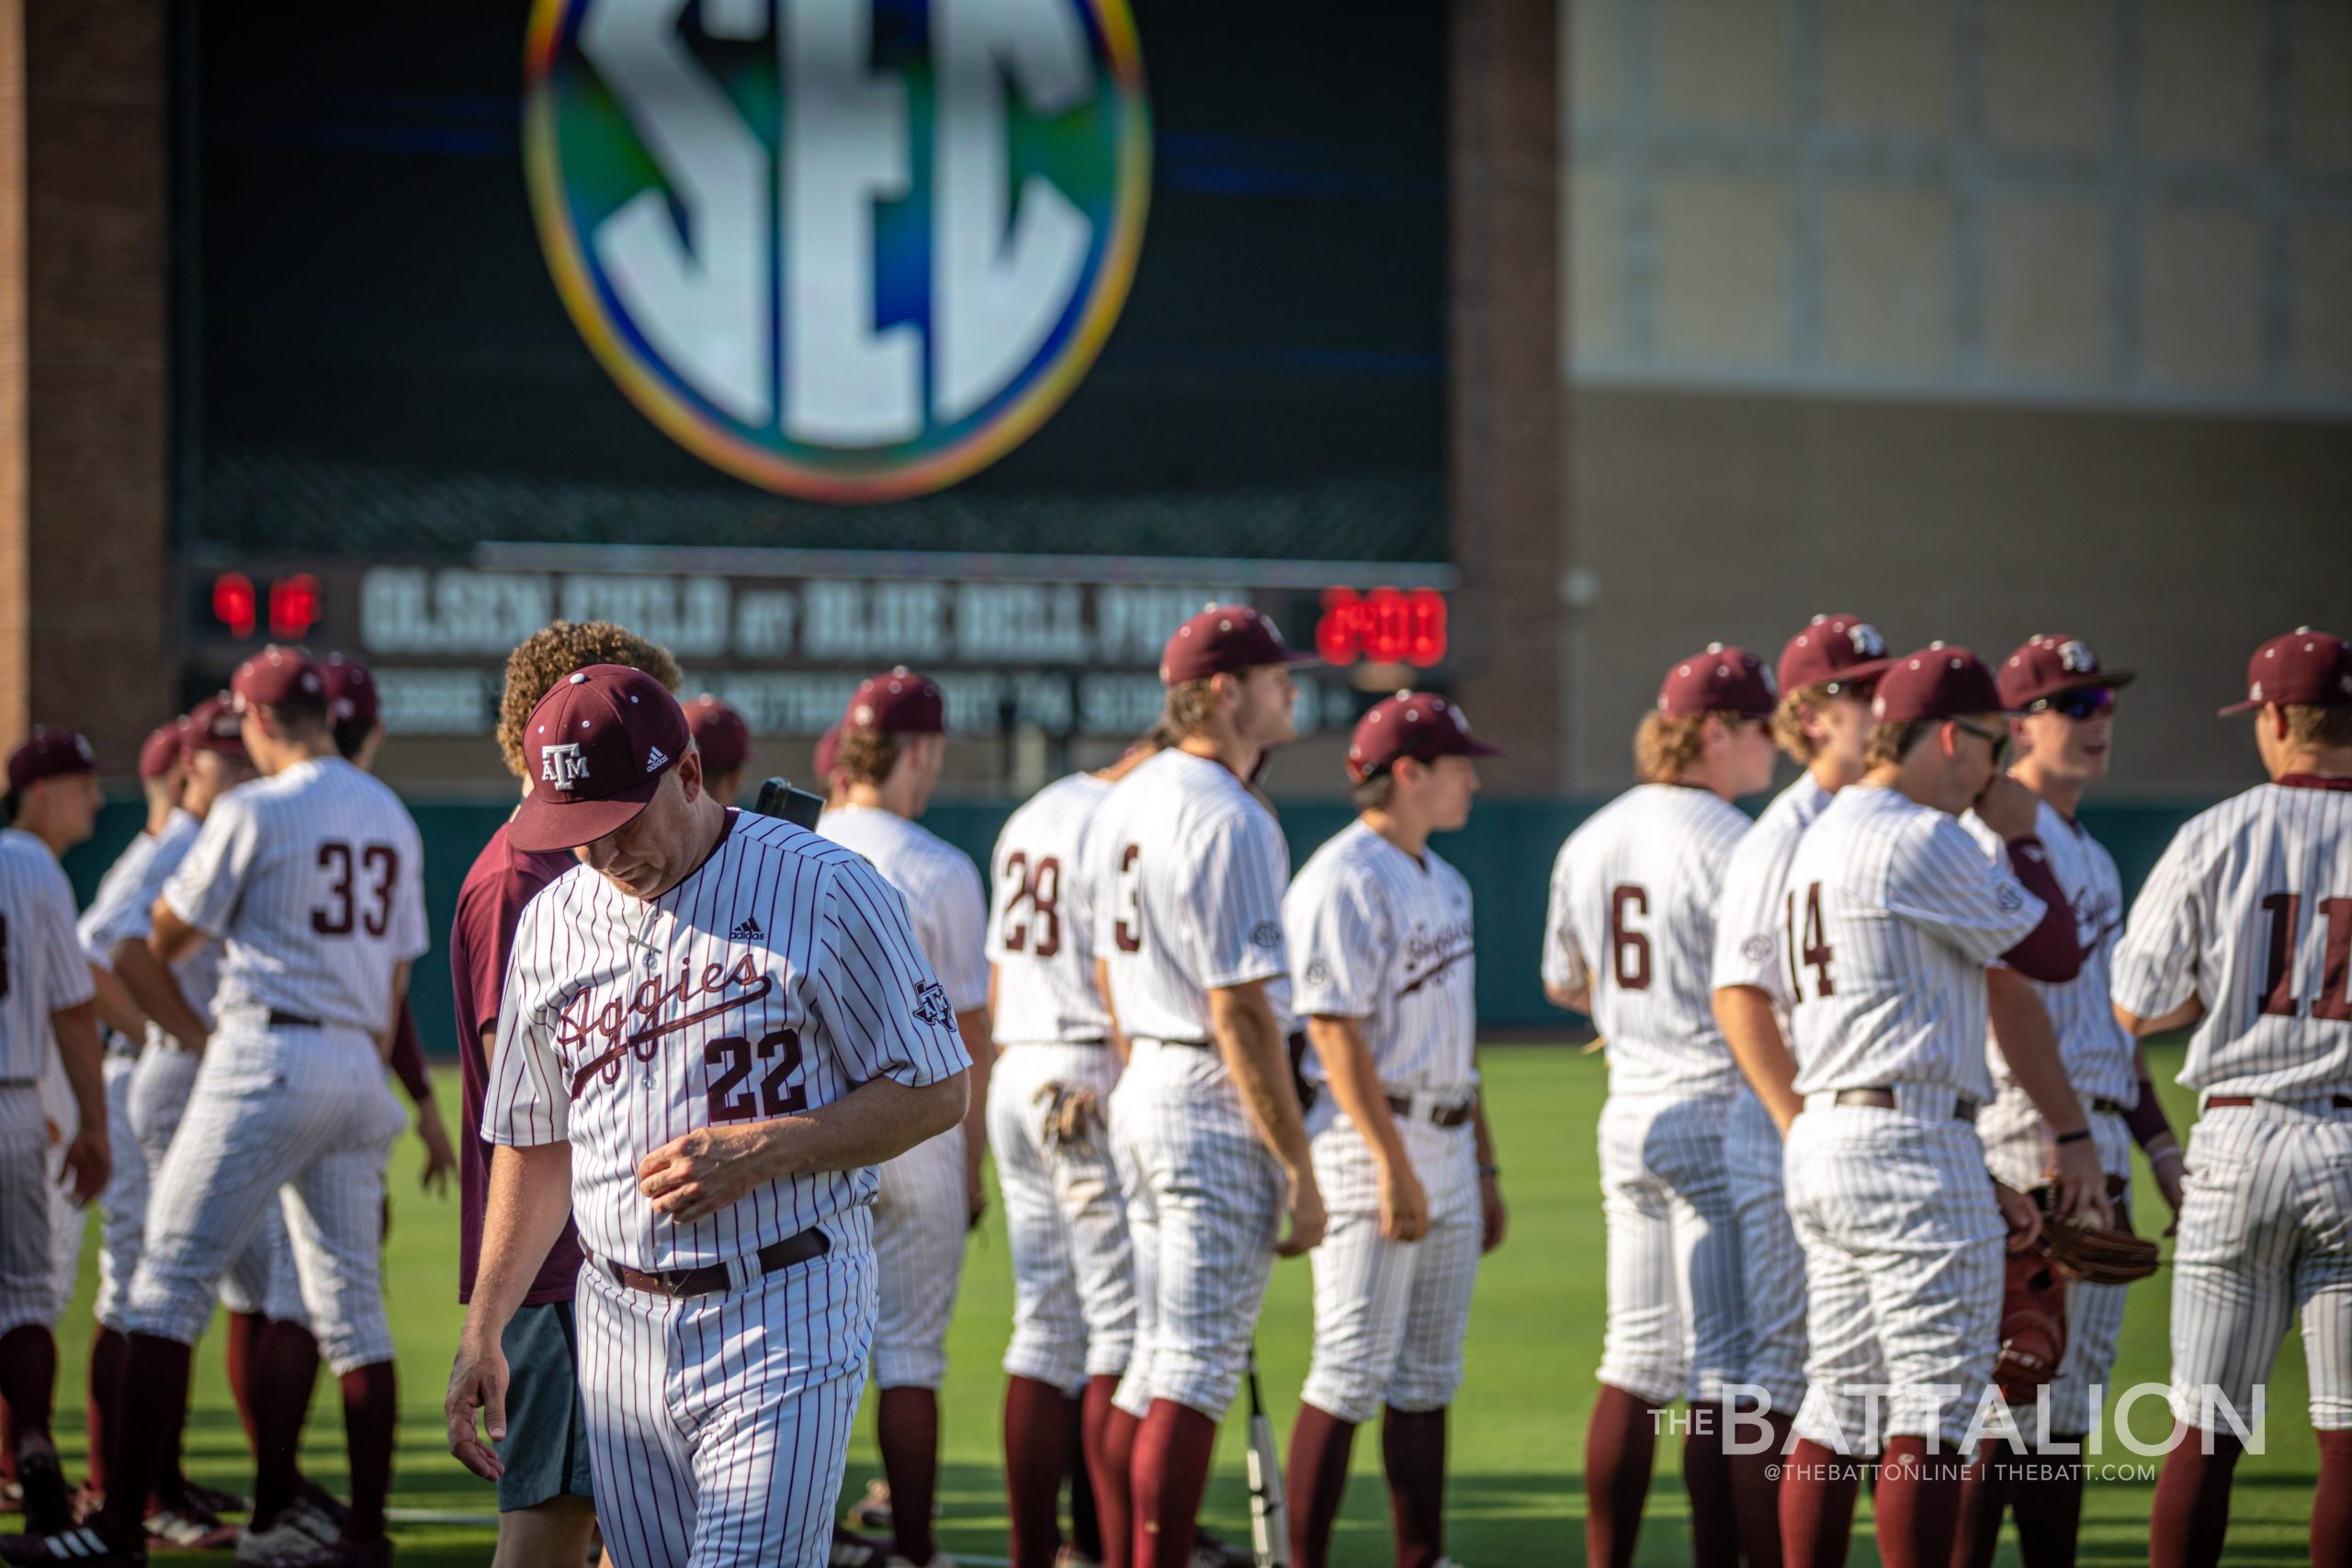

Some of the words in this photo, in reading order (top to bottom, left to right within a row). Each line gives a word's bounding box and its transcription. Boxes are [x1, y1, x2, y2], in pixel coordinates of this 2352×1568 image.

[577, 0, 1095, 446] SEC
[647, 754, 669, 773] adidas
[312, 842, 398, 936] 33
[730, 931, 764, 941] adidas
[1114, 844, 1140, 952] 3
[1612, 886, 1652, 990] 6
[556, 953, 761, 1088] Aggies
[705, 1028, 808, 1122] 22
